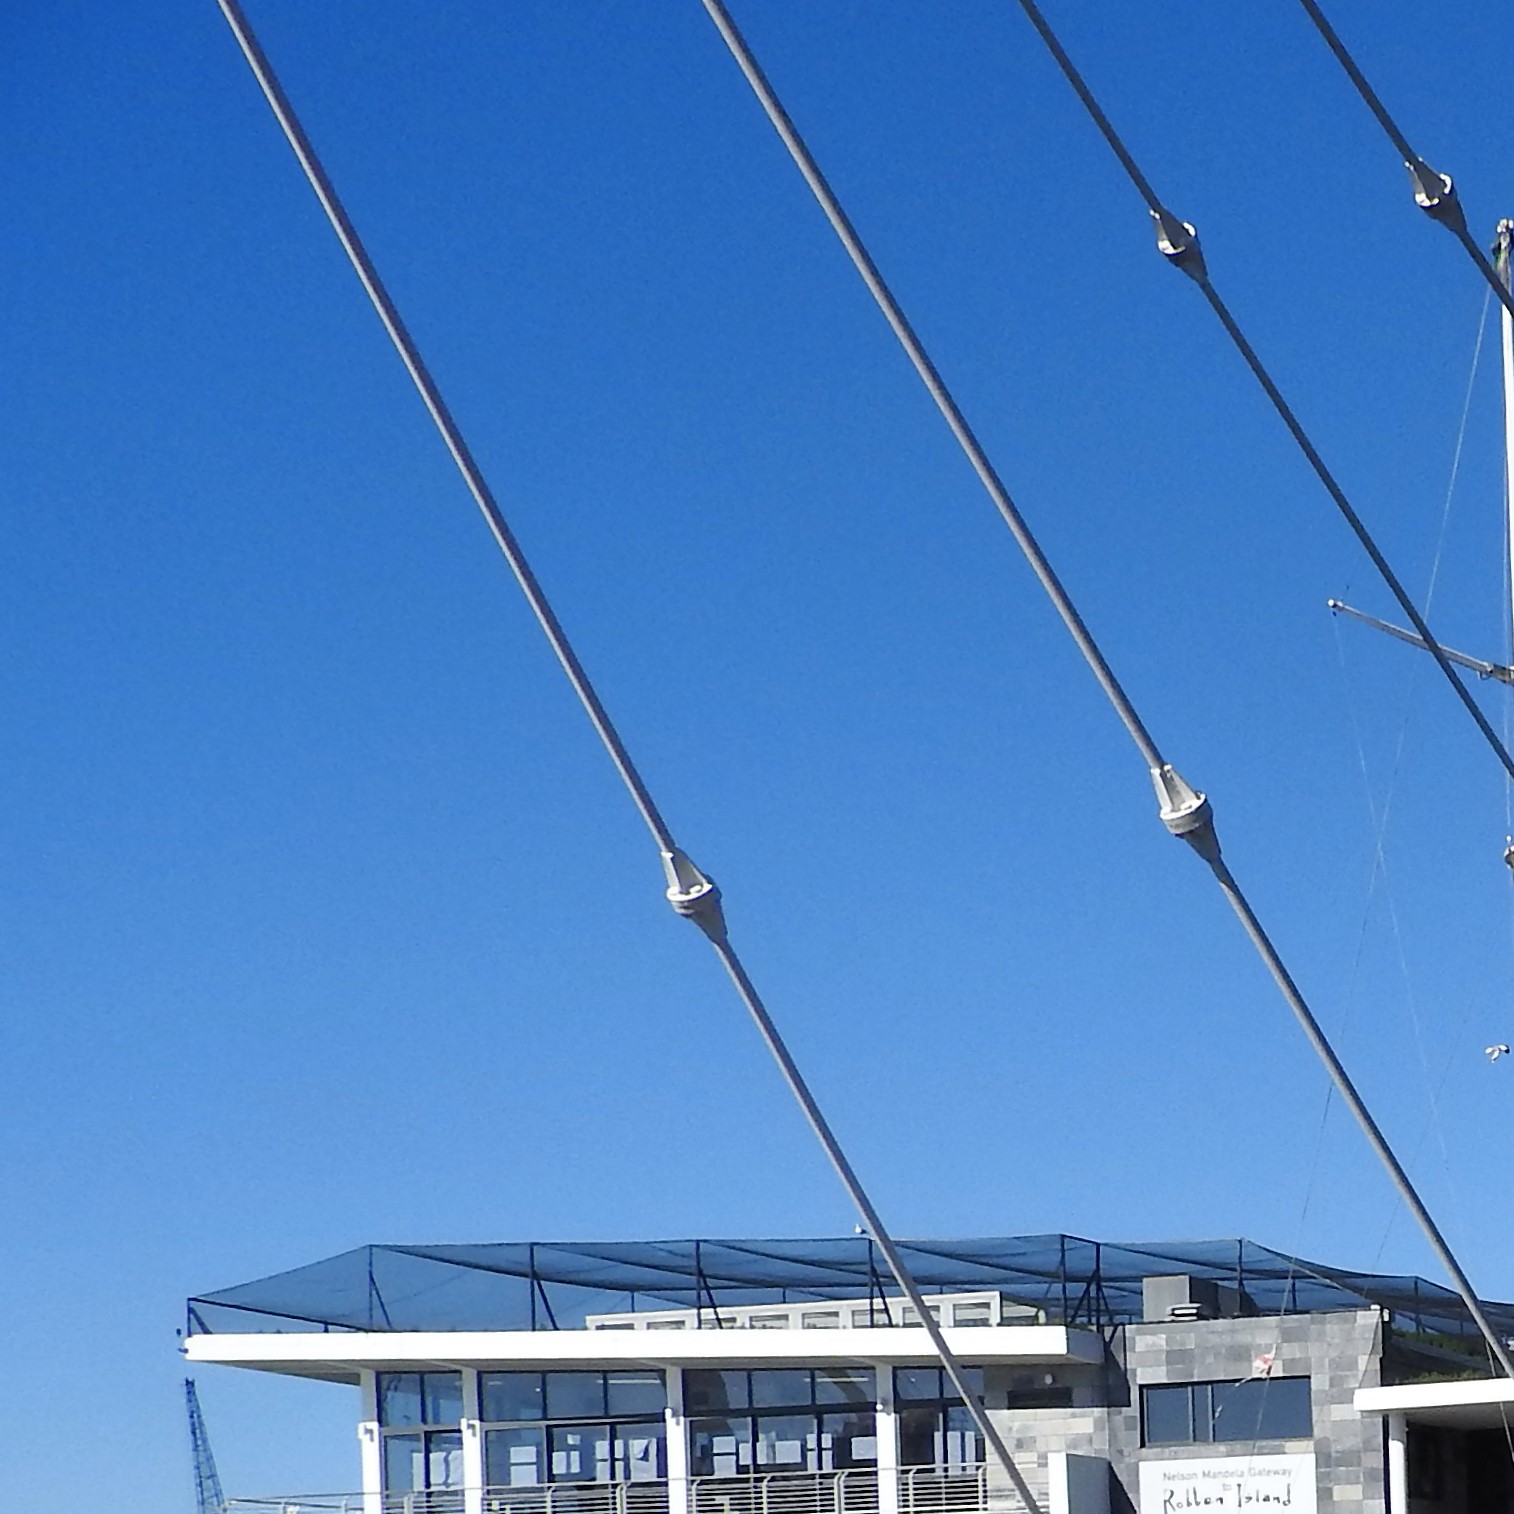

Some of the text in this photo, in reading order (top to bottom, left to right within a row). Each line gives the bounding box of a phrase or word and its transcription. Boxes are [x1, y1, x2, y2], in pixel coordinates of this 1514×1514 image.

[1162, 1466, 1293, 1482] Nelson Mandela Gateway
[1222, 1482, 1232, 1492] to
[1236, 1482, 1292, 1508] Island
